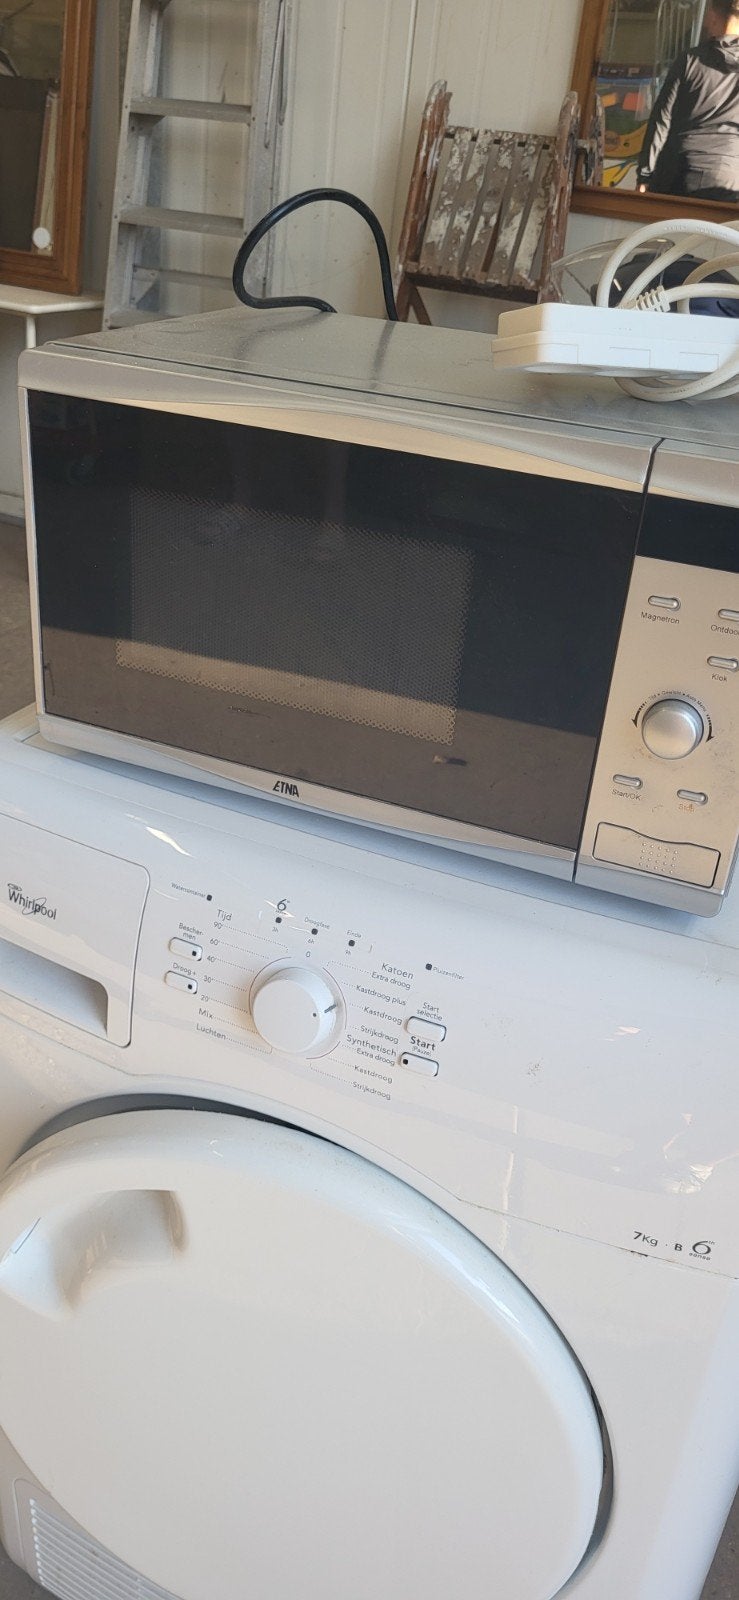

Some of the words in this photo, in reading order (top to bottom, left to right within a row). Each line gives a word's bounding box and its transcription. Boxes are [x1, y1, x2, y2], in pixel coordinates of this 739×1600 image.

[640, 611, 680, 625] Magnetron
[711, 673, 728, 683] Klok
[273, 781, 299, 798] ETNA
[611, 788, 642, 801] Start/OK
[8, 888, 57, 920] Whirlpool
[217, 909, 233, 922] Tijd
[178, 922, 205, 937] Bescher-
[182, 932, 197, 941] men
[346, 929, 362, 939] Einde
[381, 962, 415, 980] Katoen
[432, 965, 465, 981] Pluizenfilter
[371, 971, 389, 983] Extra
[389, 977, 412, 990] droog
[355, 985, 391, 1003] Kastdroog
[392, 997, 407, 1007] plus
[198, 1008, 214, 1019] Mix
[416, 1009, 443, 1021] selectie
[422, 1001, 440, 1013] Start
[363, 1007, 403, 1026] Kastdroog
[196, 1023, 227, 1041] Luchten
[360, 1025, 400, 1045] Strijkdroog
[346, 1034, 397, 1056] Synthetisch
[410, 1035, 437, 1051] Start
[356, 1048, 374, 1060] Extra
[374, 1054, 396, 1067] droog
[353, 1065, 393, 1084] Kastdroog
[352, 1081, 391, 1101] Strijkdroog
[632, 1230, 659, 1248] 7Kg
[674, 1243, 683, 1252] B
